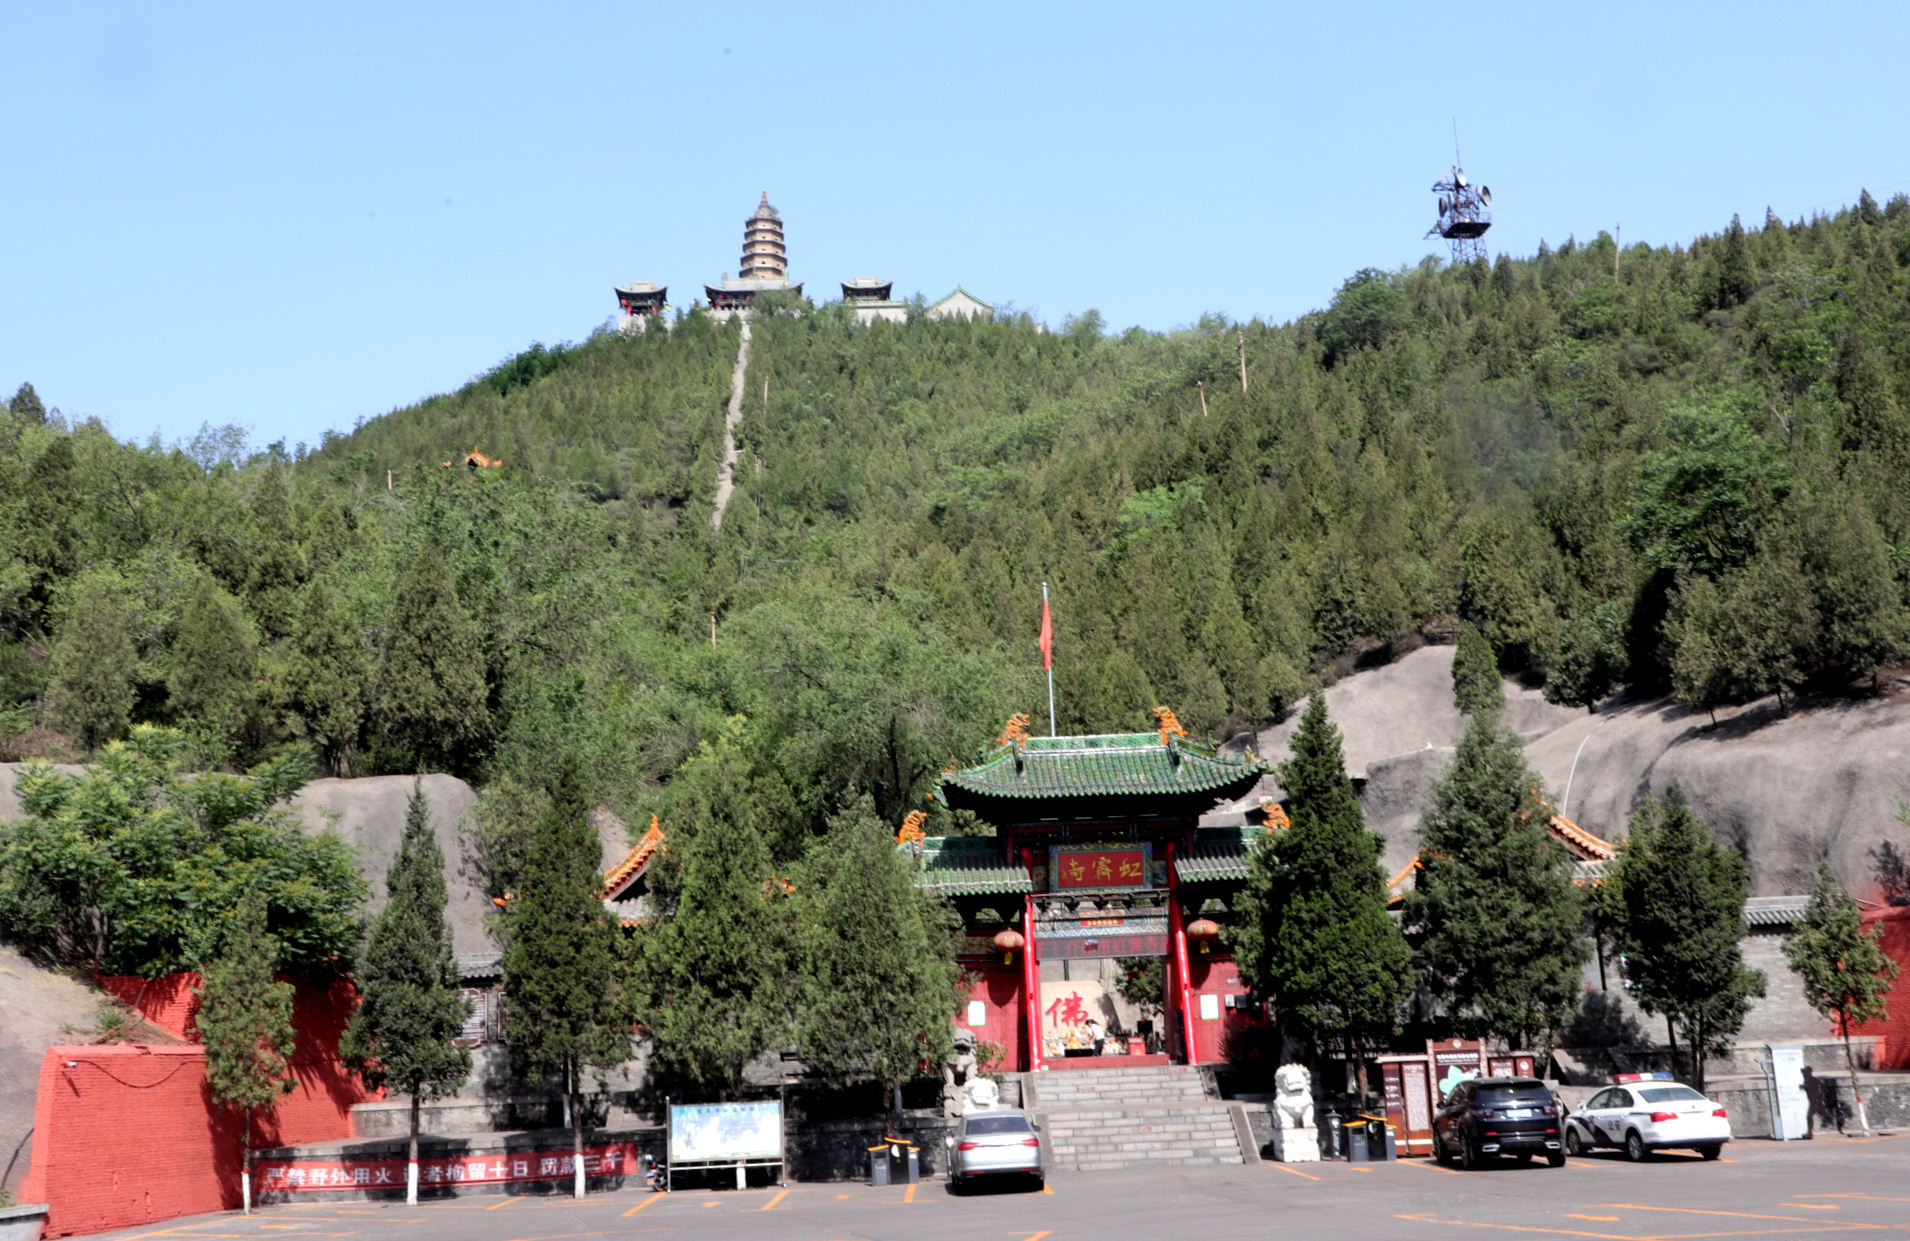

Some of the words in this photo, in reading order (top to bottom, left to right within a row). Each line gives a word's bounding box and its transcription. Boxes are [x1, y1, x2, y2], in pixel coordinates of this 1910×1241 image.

[1045, 991, 1089, 1029] 佛
[265, 1166, 392, 1186] 严禁野外用火
[540, 1151, 624, 1176] 罚款三千
